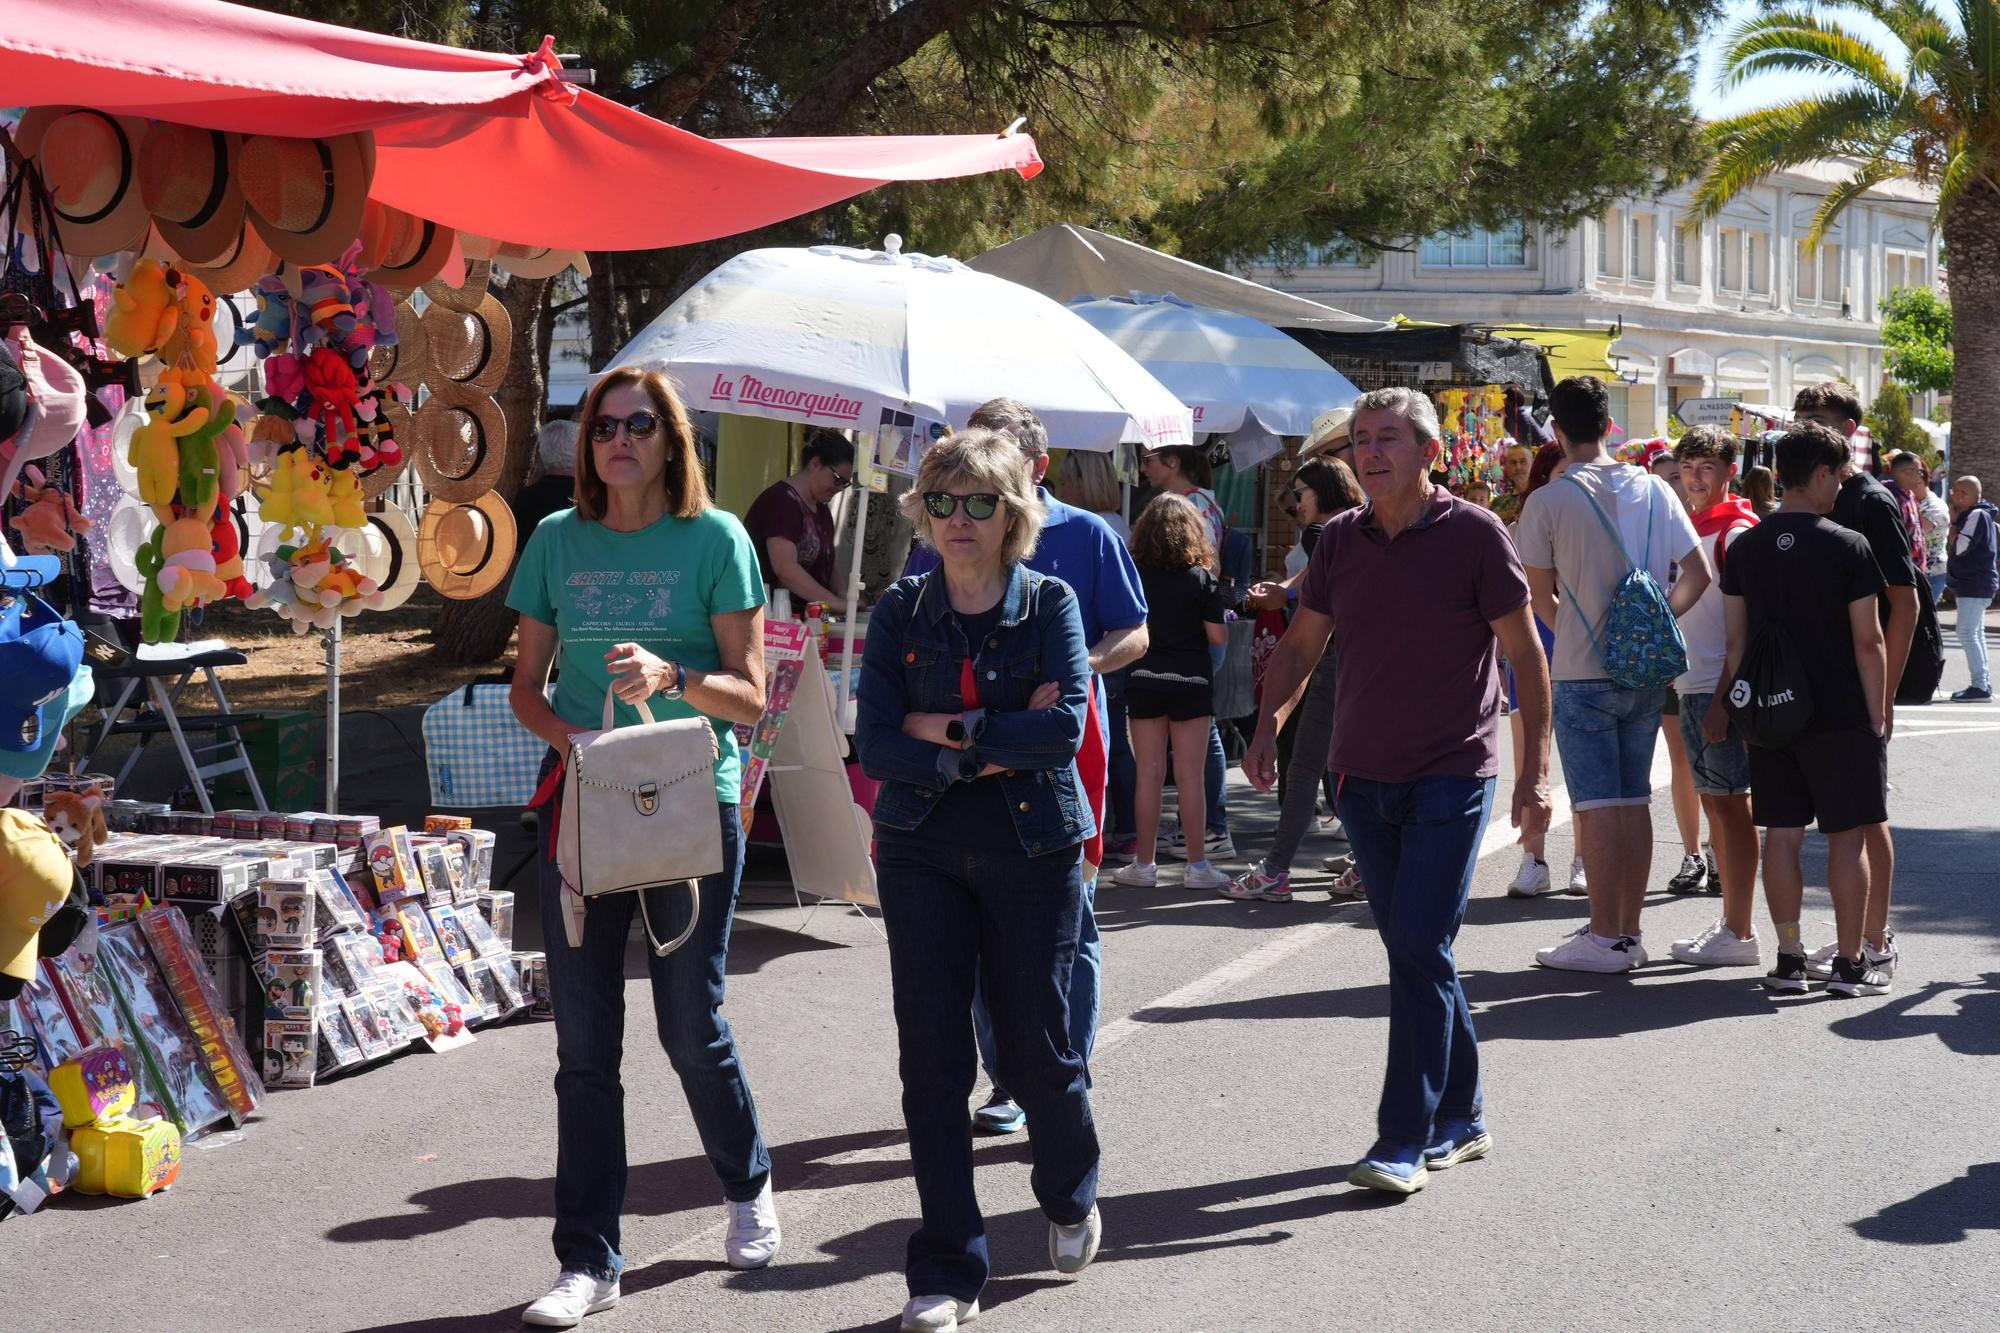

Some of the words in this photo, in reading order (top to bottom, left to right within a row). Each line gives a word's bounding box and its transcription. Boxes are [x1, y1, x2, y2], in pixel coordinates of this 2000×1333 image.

[710, 373, 734, 397] la
[739, 374, 864, 418] Menorquina
[565, 571, 625, 586] EARTH
[627, 571, 681, 586] SIGNS
